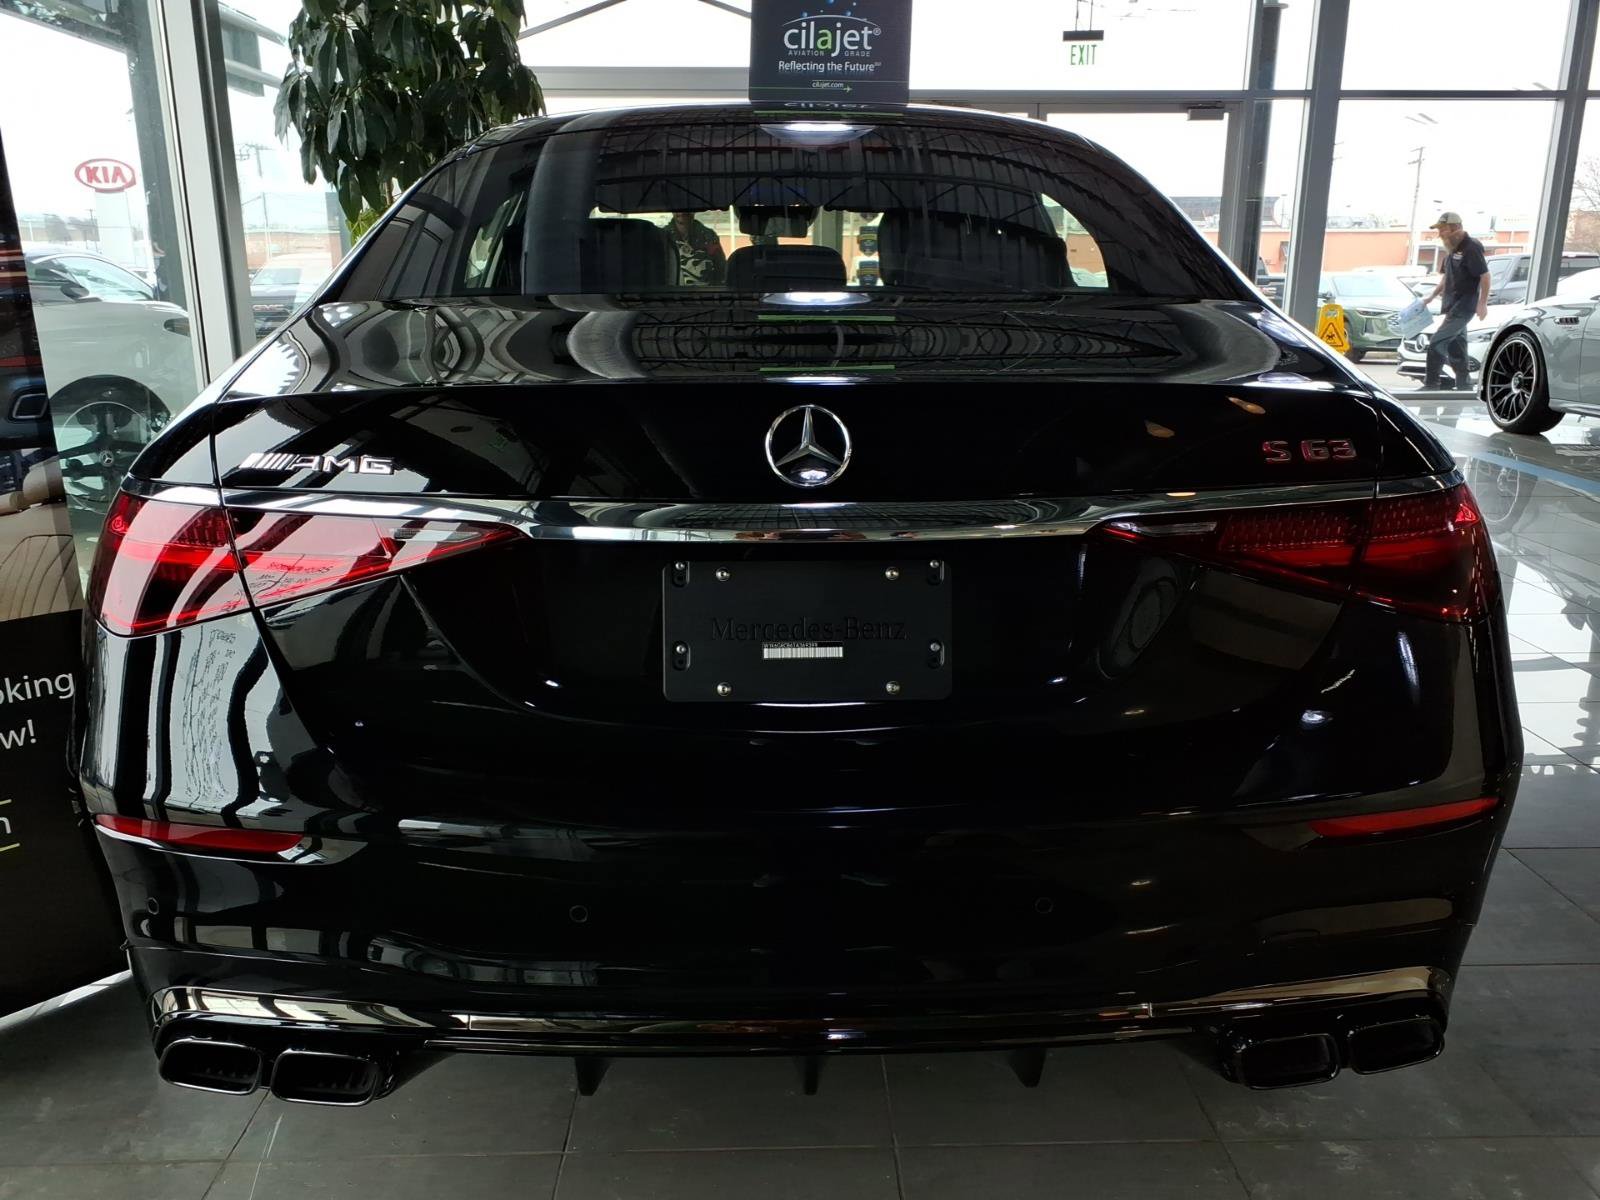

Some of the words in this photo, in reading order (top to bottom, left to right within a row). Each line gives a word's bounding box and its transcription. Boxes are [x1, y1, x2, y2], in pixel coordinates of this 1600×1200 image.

[778, 60, 825, 72] Reflecting
[827, 61, 843, 71] the
[844, 61, 875, 72] Future
[1070, 44, 1098, 66] EXIT
[811, 81, 844, 89] cilajet.com
[85, 165, 127, 184] KIA
[1263, 440, 1293, 463] S
[1300, 438, 1358, 463] 63
[285, 453, 395, 475] AMG
[711, 616, 907, 641] Mercedes-Benz
